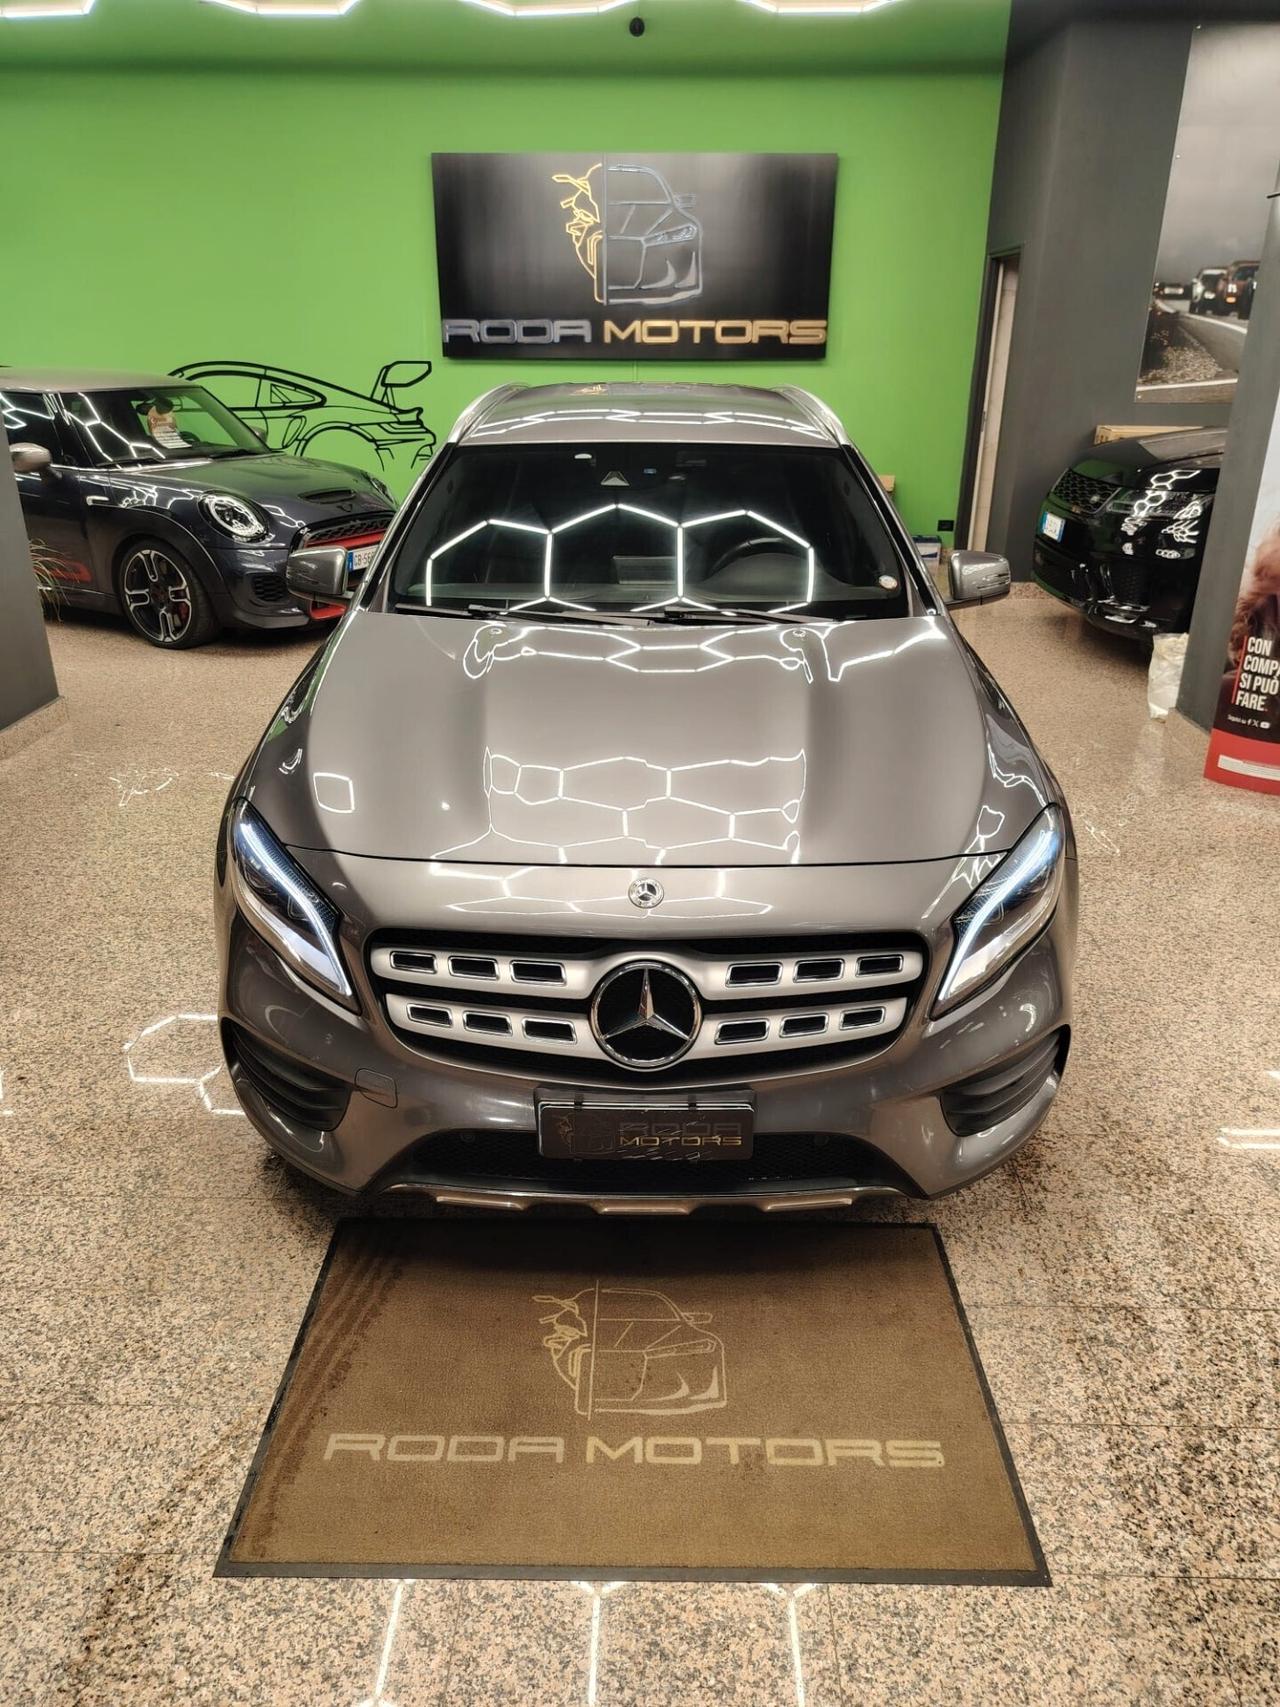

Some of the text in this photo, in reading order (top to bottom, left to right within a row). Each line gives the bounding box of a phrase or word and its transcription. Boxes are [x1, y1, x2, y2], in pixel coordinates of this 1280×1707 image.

[443, 319, 828, 344] RODA MOTORS
[1247, 636, 1272, 656] CON
[1239, 672, 1279, 695] SI PUÒ
[619, 1136, 742, 1146] MOTORS
[323, 1433, 944, 1467] RODA MOTORS
